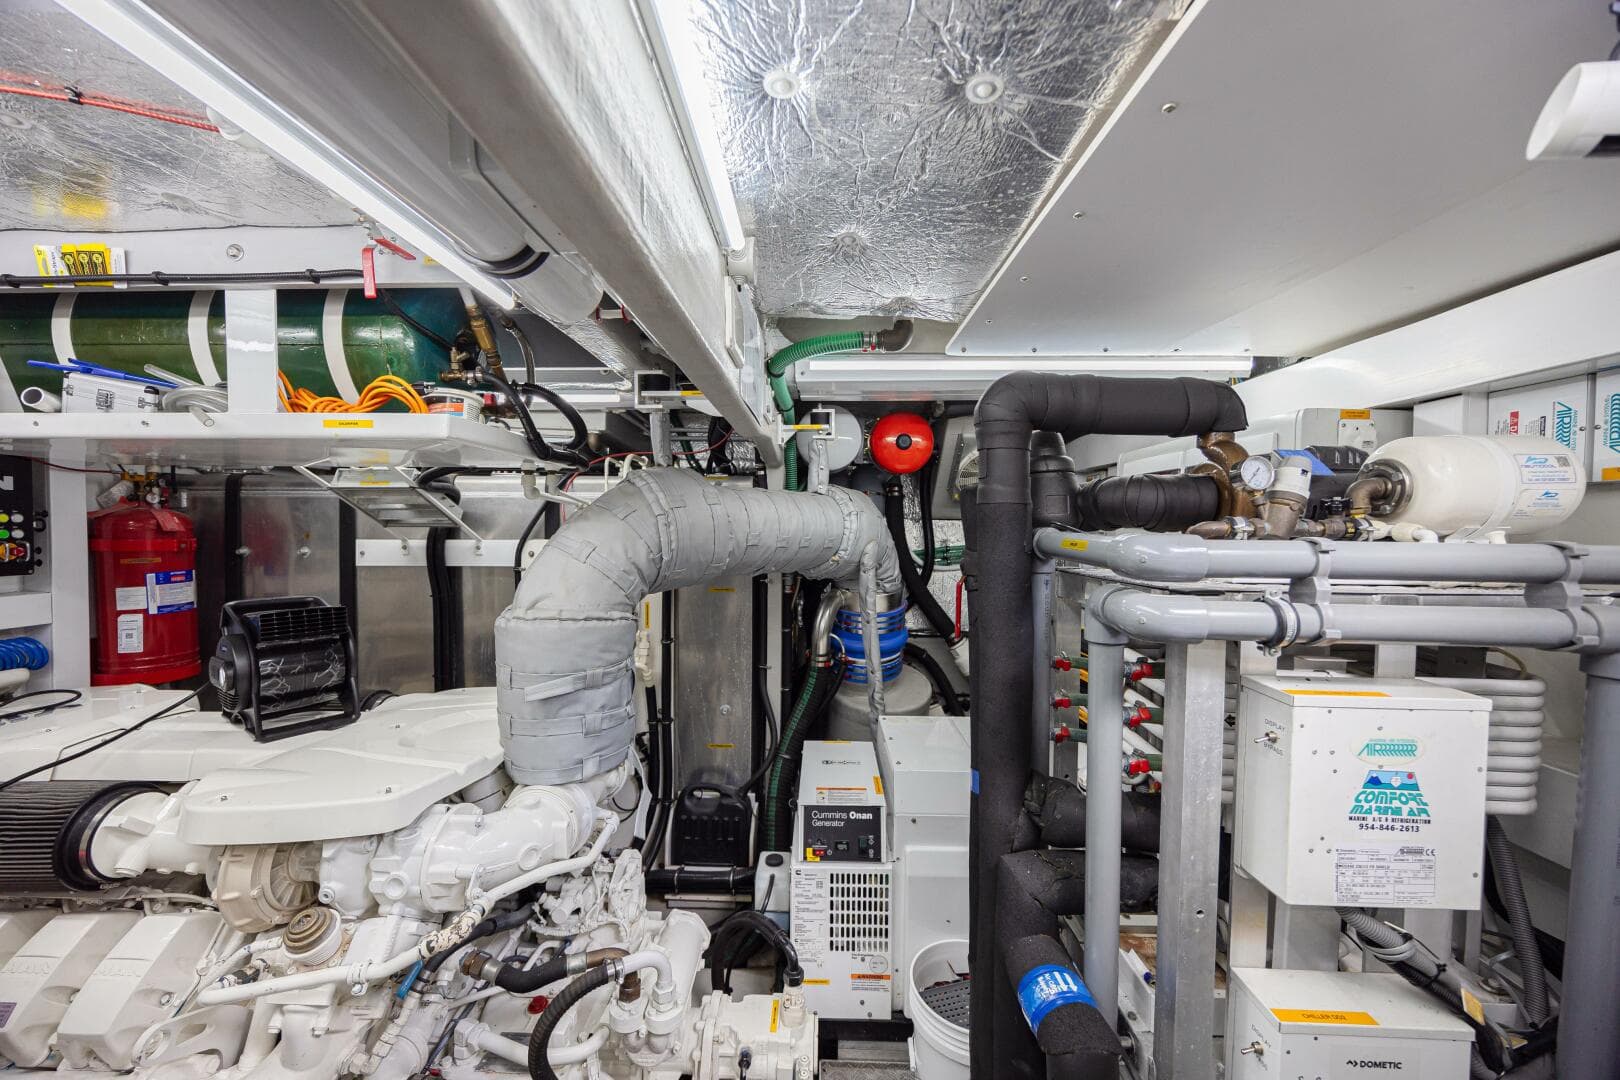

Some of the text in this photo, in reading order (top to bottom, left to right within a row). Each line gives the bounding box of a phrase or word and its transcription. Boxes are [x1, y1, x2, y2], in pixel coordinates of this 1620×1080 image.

[1264, 718, 1286, 733] DISPLAY
[1354, 790, 1429, 807] COMFORT
[811, 810, 873, 820] Cummins Onan
[1349, 804, 1431, 818] MARINE AIR
[811, 819, 845, 827] Generator
[1391, 817, 1432, 825] REFRIGERATION
[1358, 823, 1420, 832] 954-846-2613
[1360, 1060, 1402, 1070] DOMETIC
